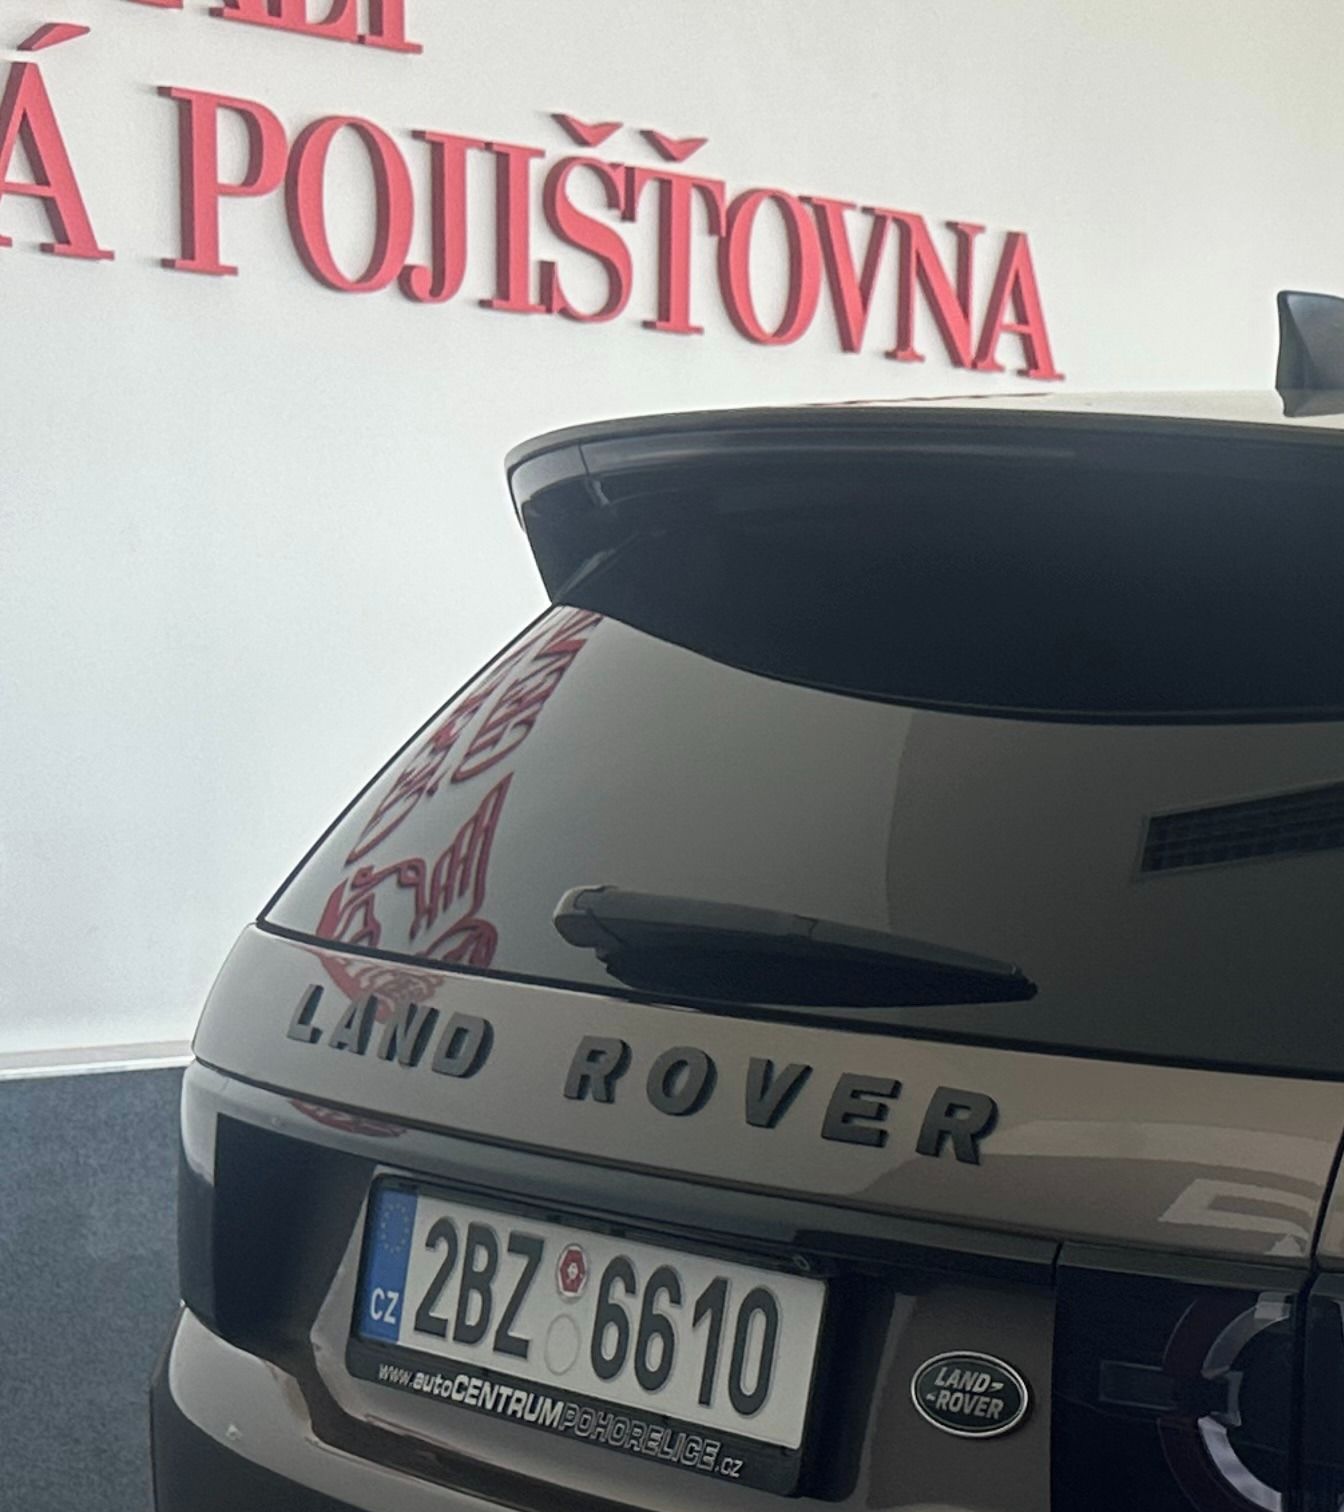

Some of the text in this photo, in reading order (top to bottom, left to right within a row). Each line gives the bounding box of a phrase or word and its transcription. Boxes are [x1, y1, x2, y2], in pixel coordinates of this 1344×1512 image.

[157, 85, 1066, 381] POJIŠŤOVNA
[287, 983, 1000, 1167] LAND ROVER
[370, 1288, 399, 1325] CZ
[413, 1215, 781, 1418] 2BZ 6610
